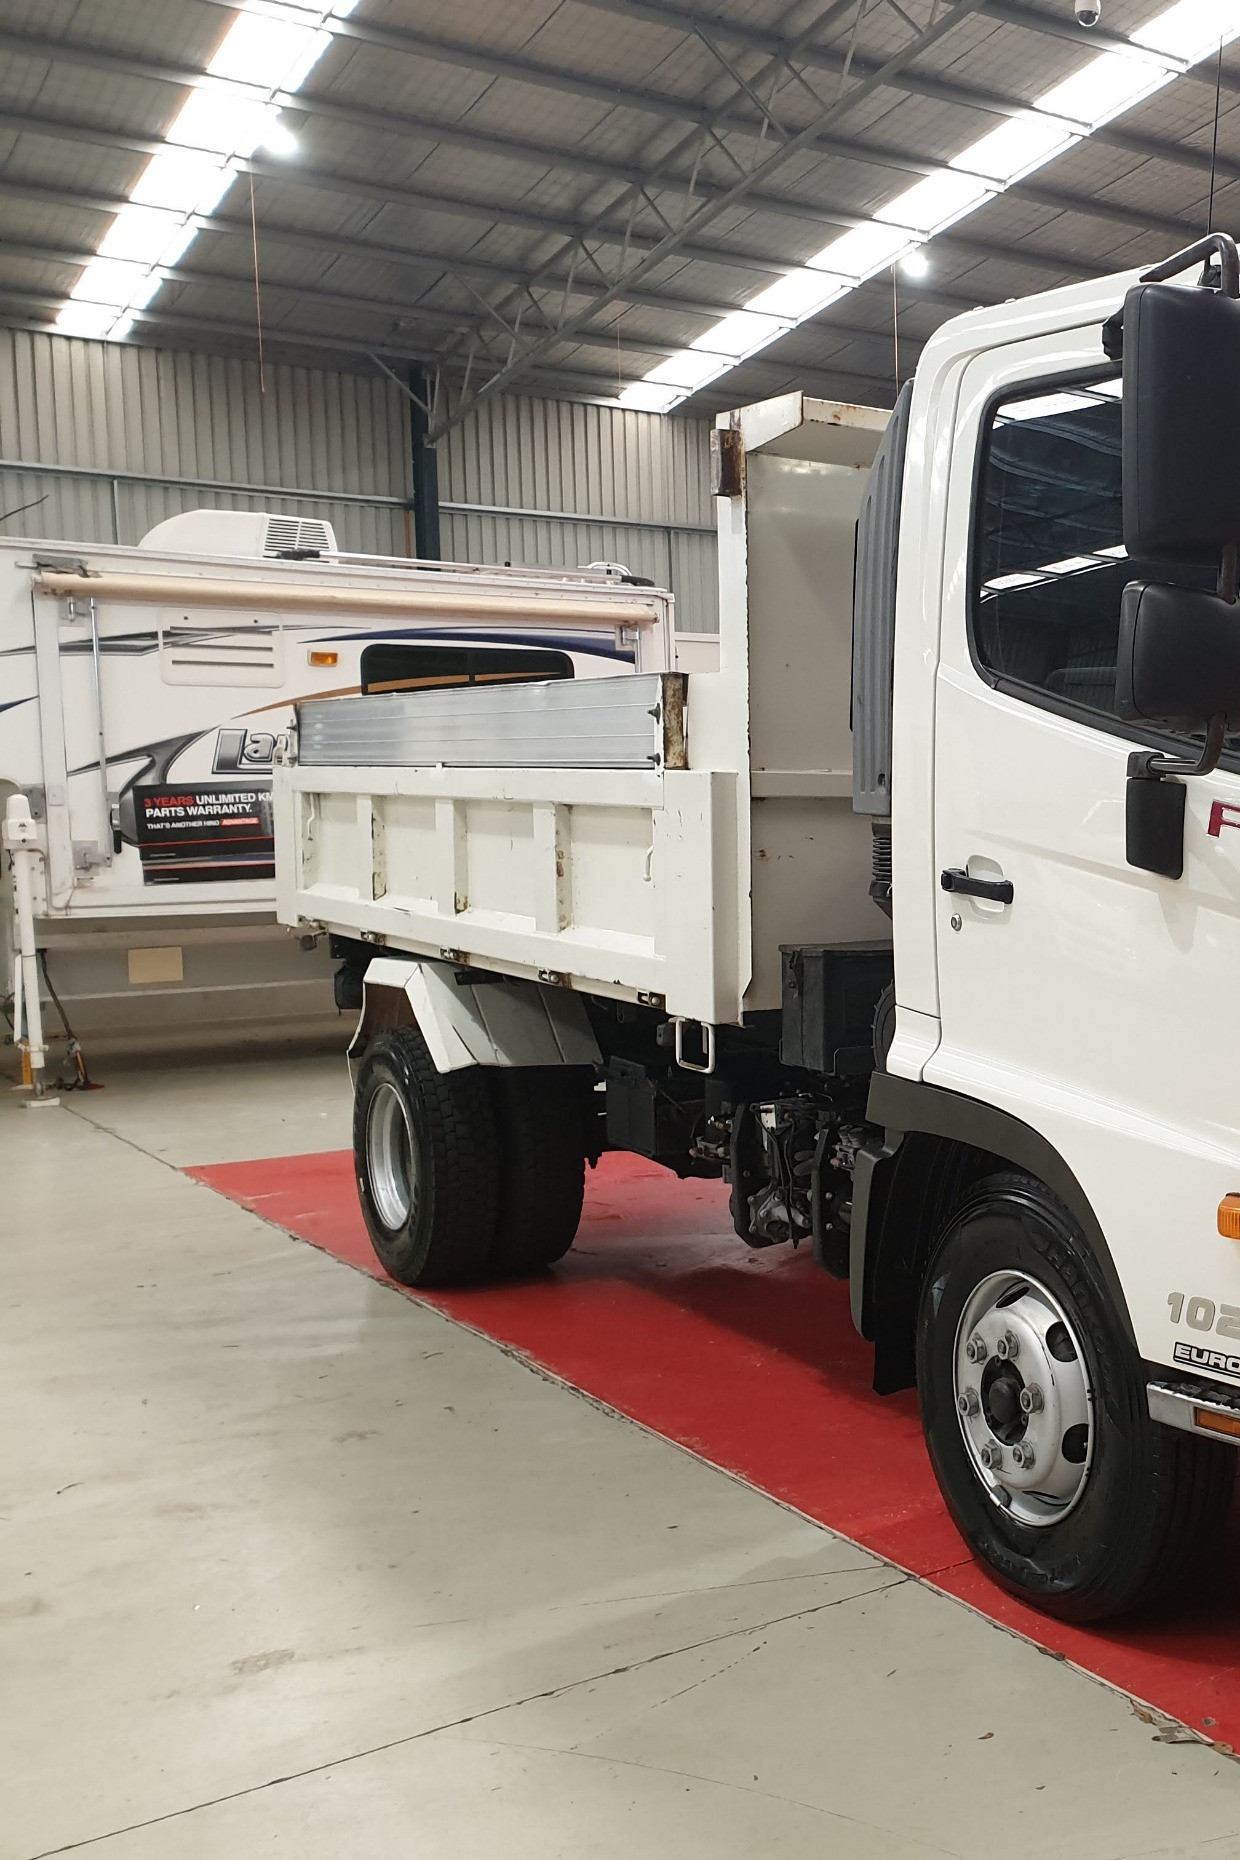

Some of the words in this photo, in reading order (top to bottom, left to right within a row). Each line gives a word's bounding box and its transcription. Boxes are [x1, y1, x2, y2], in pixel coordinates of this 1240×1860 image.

[144, 799, 152, 807] 3
[154, 796, 194, 807] YEARS
[195, 792, 256, 805] UNLIMITED
[146, 805, 185, 818] PARTS
[187, 803, 253, 816] WARRANTY.
[147, 822, 171, 830] THAT'S
[171, 820, 202, 829] ANOTHER
